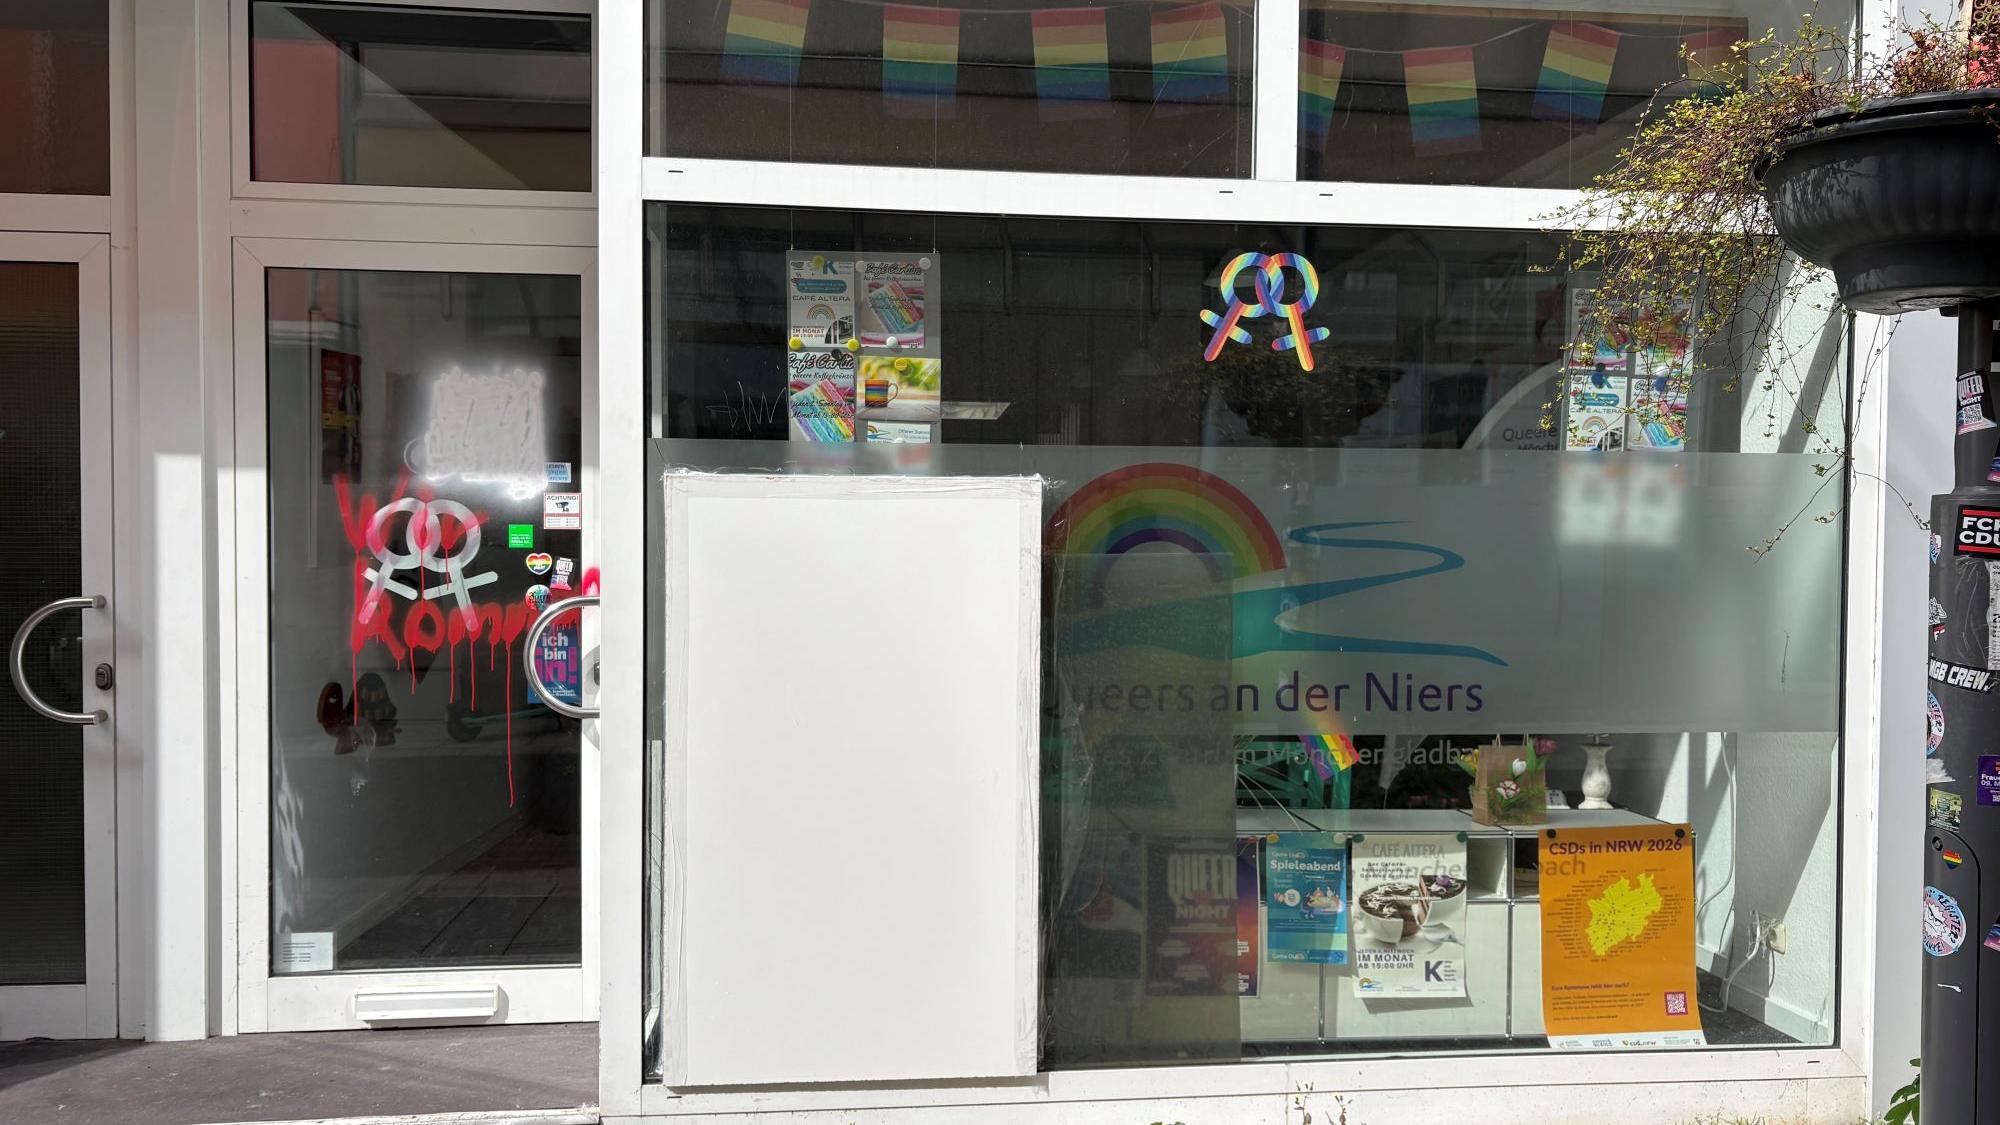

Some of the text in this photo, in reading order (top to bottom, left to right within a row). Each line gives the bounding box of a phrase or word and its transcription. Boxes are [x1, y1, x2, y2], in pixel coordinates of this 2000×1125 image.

[1958, 375, 1985, 400] QUEER
[542, 632, 569, 647] ich
[543, 648, 567, 660] bin
[1210, 682, 1260, 712] an
[1275, 670, 1351, 713] der
[1364, 670, 1483, 713] Niers
[1403, 844, 1446, 859] ALTERA
[1549, 838, 1683, 855] CSDs in NRW 2026
[1270, 859, 1341, 872] Spieleabend
[1358, 954, 1415, 962] IM MONAT
[1424, 960, 1444, 982] K
